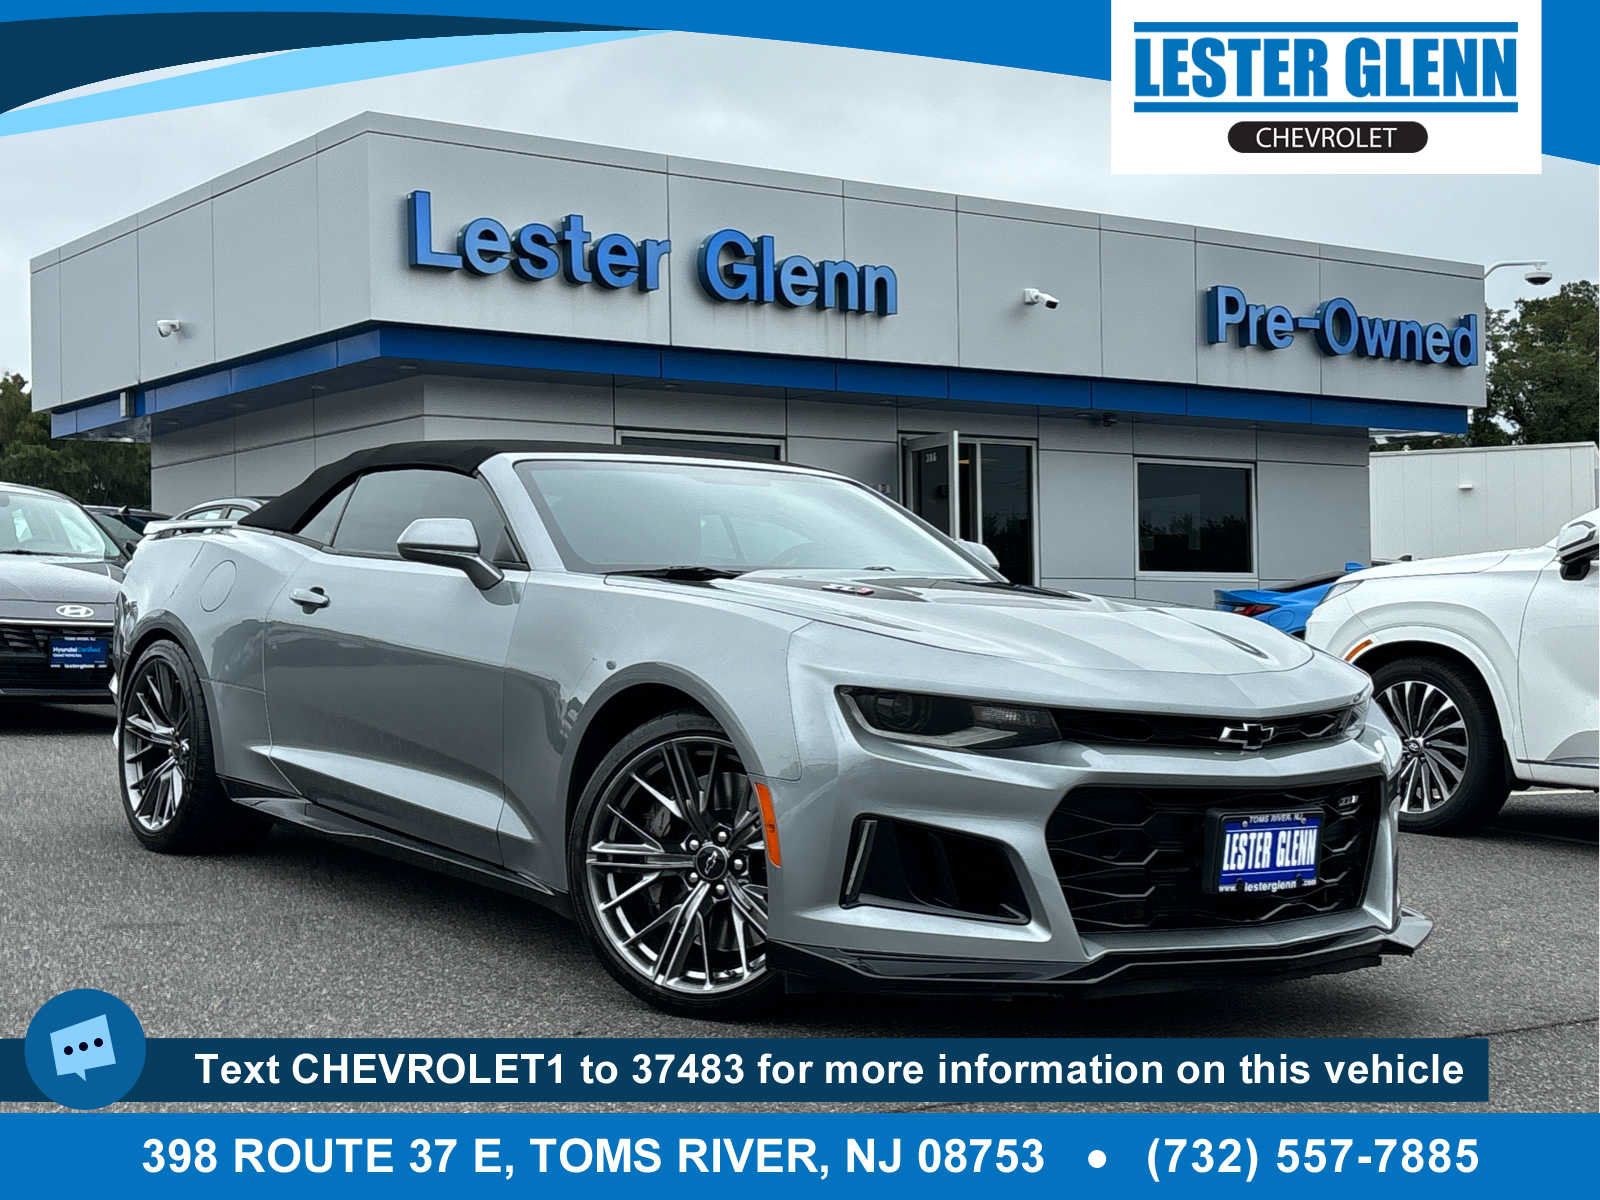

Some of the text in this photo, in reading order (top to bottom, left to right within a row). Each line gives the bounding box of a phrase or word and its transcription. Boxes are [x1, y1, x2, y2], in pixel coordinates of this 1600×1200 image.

[407, 190, 899, 316] Lester Glenn
[1207, 285, 1479, 367] Pre-Owned
[1249, 815, 1269, 823] TOMS
[1222, 829, 1318, 871] LESTER GLENN
[1244, 880, 1297, 893] lesterglenn
